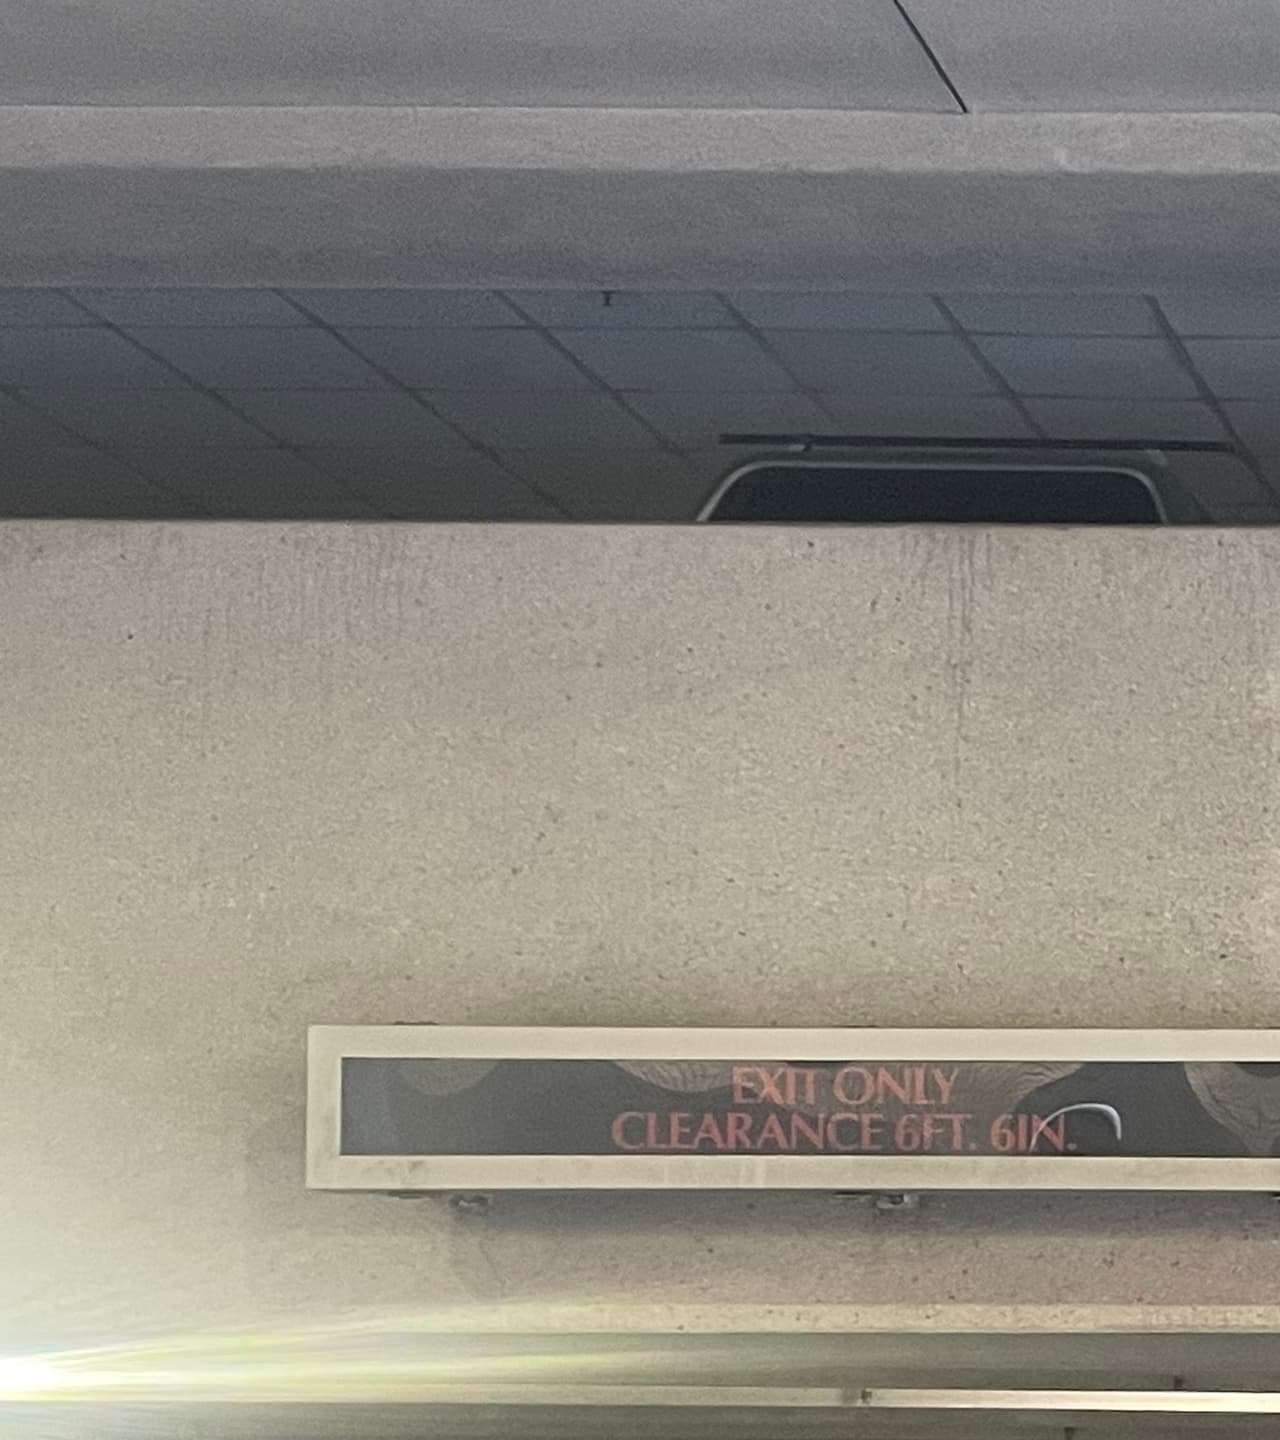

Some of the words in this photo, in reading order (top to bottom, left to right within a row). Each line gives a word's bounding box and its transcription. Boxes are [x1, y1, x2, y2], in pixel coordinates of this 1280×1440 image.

[732, 1066, 816, 1105] EXIT
[833, 1066, 960, 1105] ONLY
[610, 1111, 883, 1152] CLEARANCE
[895, 1112, 977, 1152] 6FT.
[990, 1112, 1077, 1152] 6IN.
